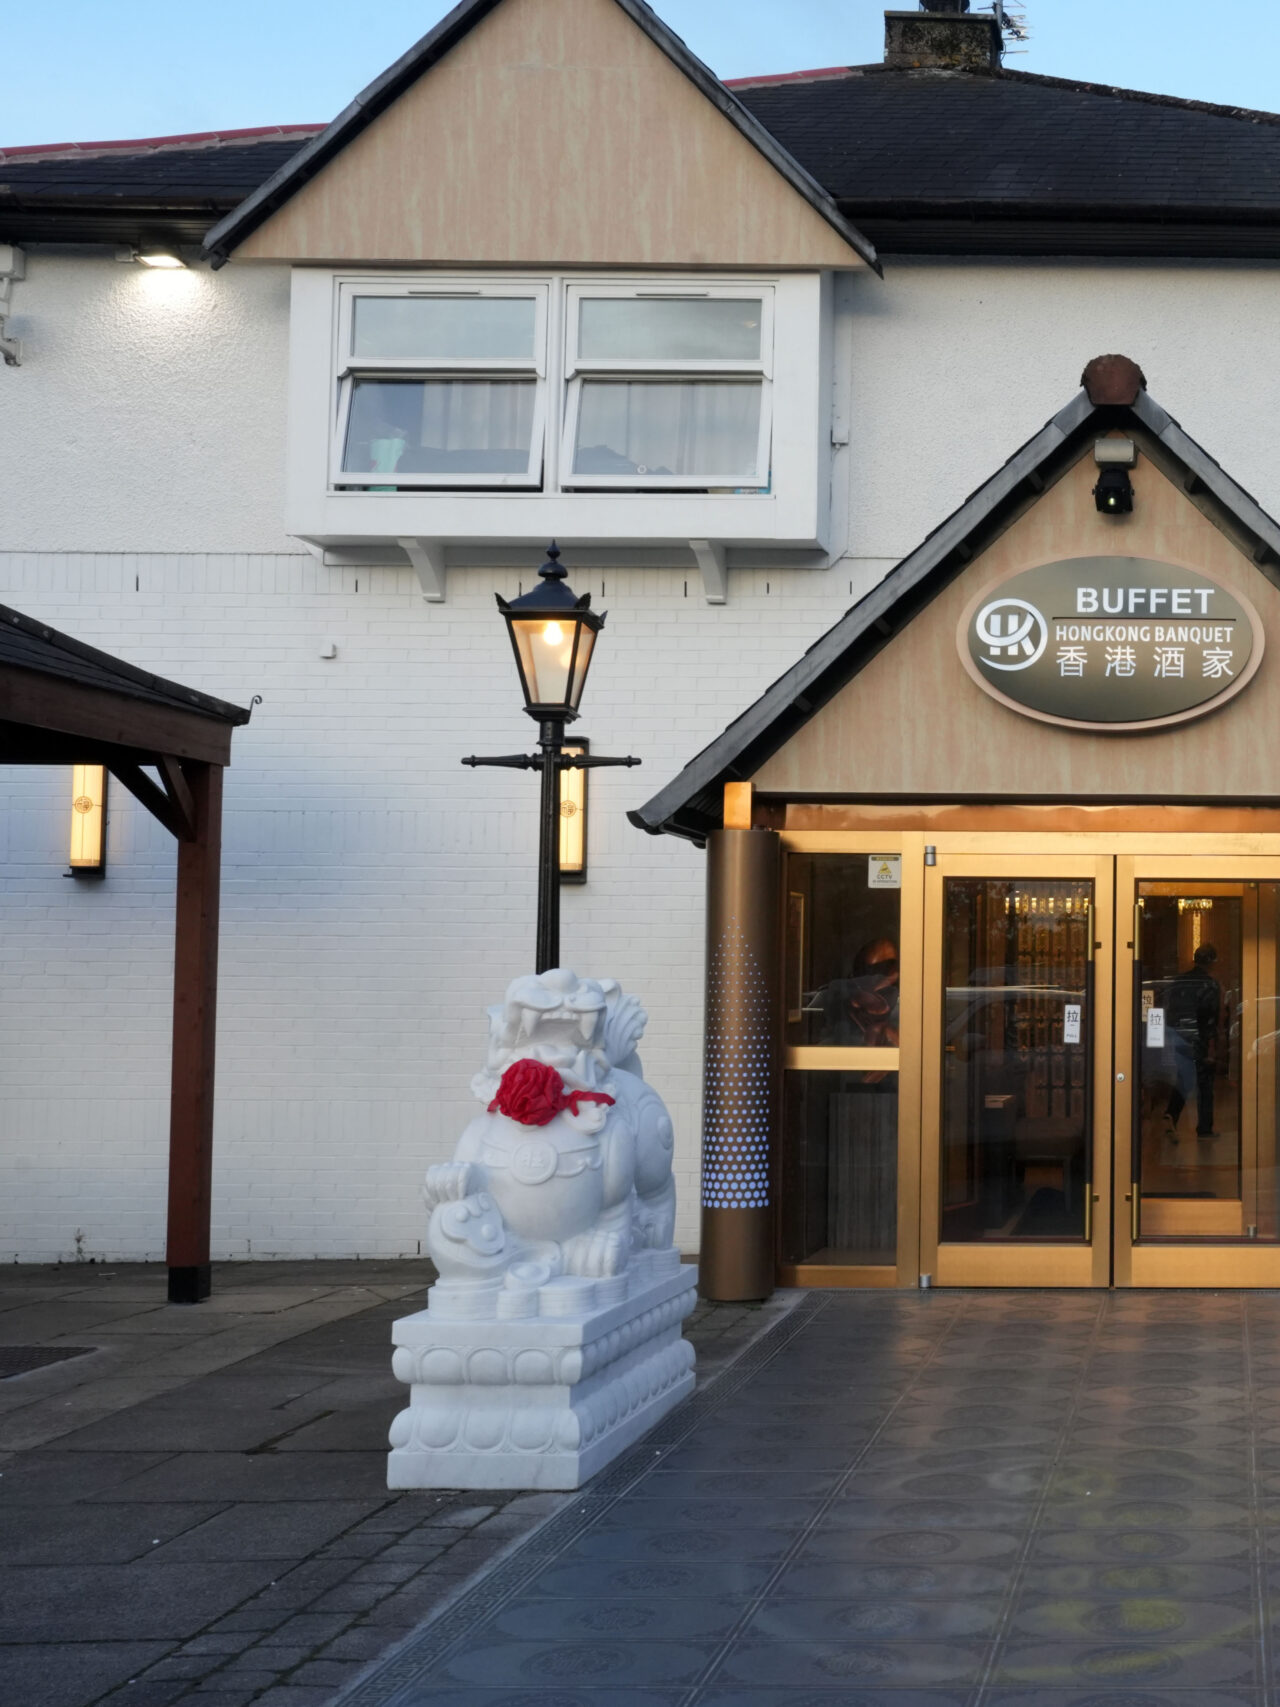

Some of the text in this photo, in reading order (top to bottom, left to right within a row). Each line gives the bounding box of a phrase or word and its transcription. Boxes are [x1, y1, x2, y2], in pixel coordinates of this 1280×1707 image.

[1076, 587, 1215, 615] BUFFET
[1055, 625, 1234, 645] HONGKONG BANQUET
[1055, 645, 1235, 678] 香港酒家
[1066, 1009, 1079, 1023] 拉
[1150, 1013, 1162, 1026] 拉
